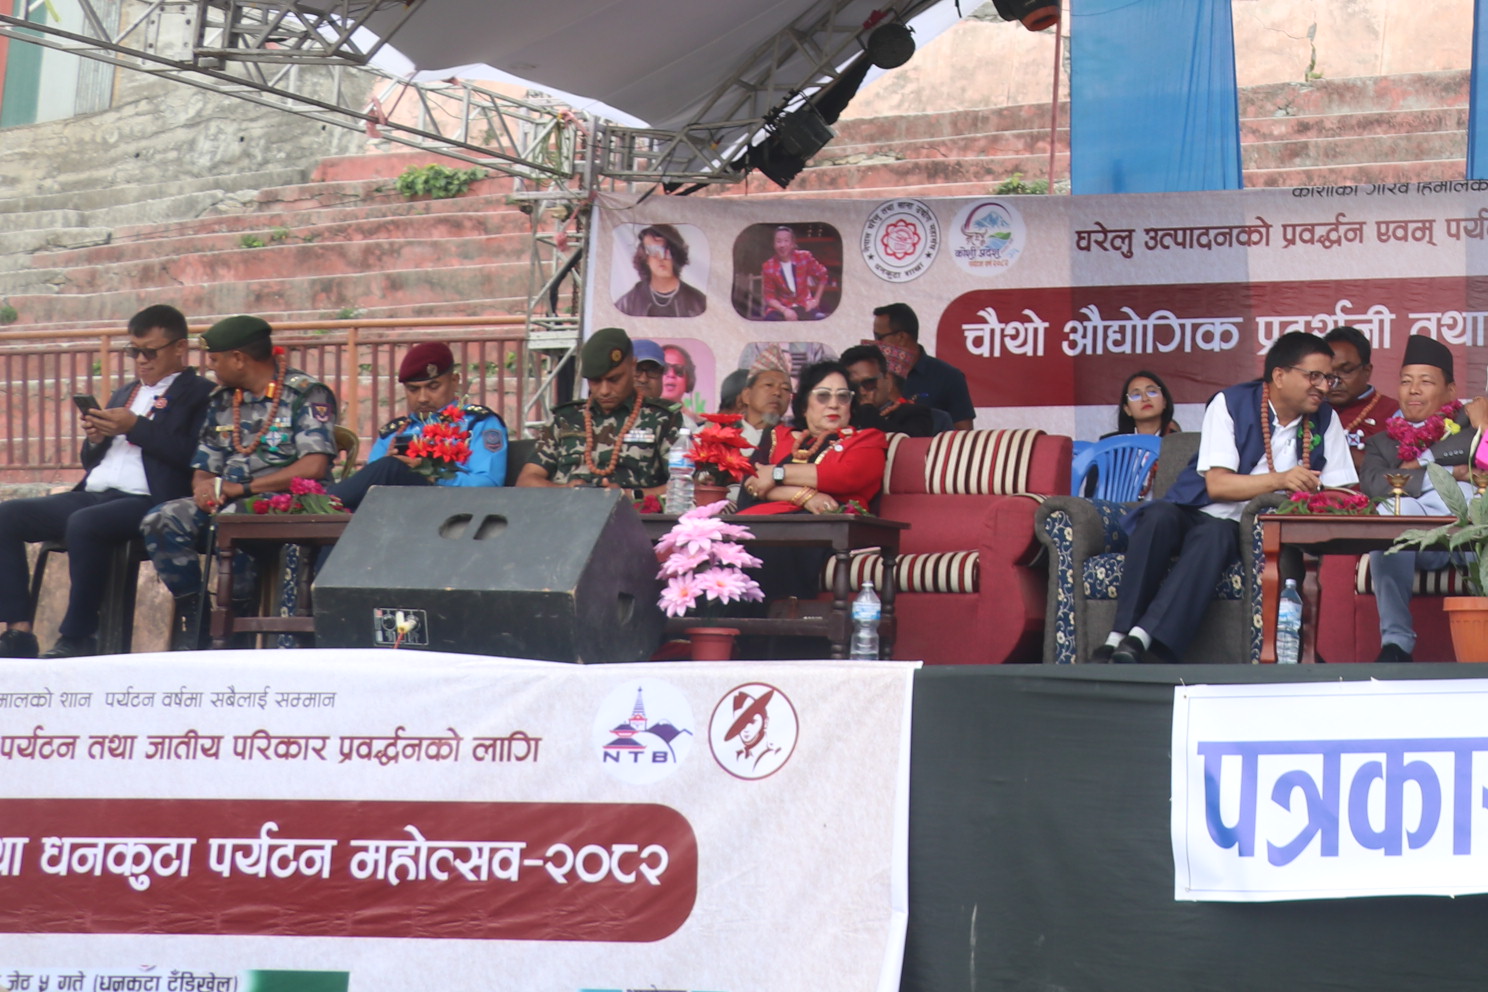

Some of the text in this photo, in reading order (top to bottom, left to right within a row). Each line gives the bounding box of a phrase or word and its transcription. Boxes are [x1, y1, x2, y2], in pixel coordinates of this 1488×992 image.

[1075, 221, 1135, 259] घरेलु
[1144, 216, 1273, 251] उत्पादनको
[1375, 219, 1438, 247] एवम्
[962, 307, 1049, 358] चौथो
[1061, 304, 1244, 357] औद्योगिक
[1409, 309, 1488, 346] तथा
[60, 692, 93, 708] शान
[105, 686, 156, 708] पर्यटन
[162, 686, 203, 708] वर्षमा
[210, 685, 271, 710] सबैलाई
[275, 692, 337, 708] सम्मान
[1, 725, 543, 766] पर्यटन तथा जातीय परिकार प्रवर्द्धनको लागि
[602, 750, 669, 764] NTB
[40, 836, 197, 891] धनकुटा
[209, 821, 338, 879] पर्यटन
[350, 824, 669, 885] महोत्सव-२०८२
[57, 971, 87, 991] गते
